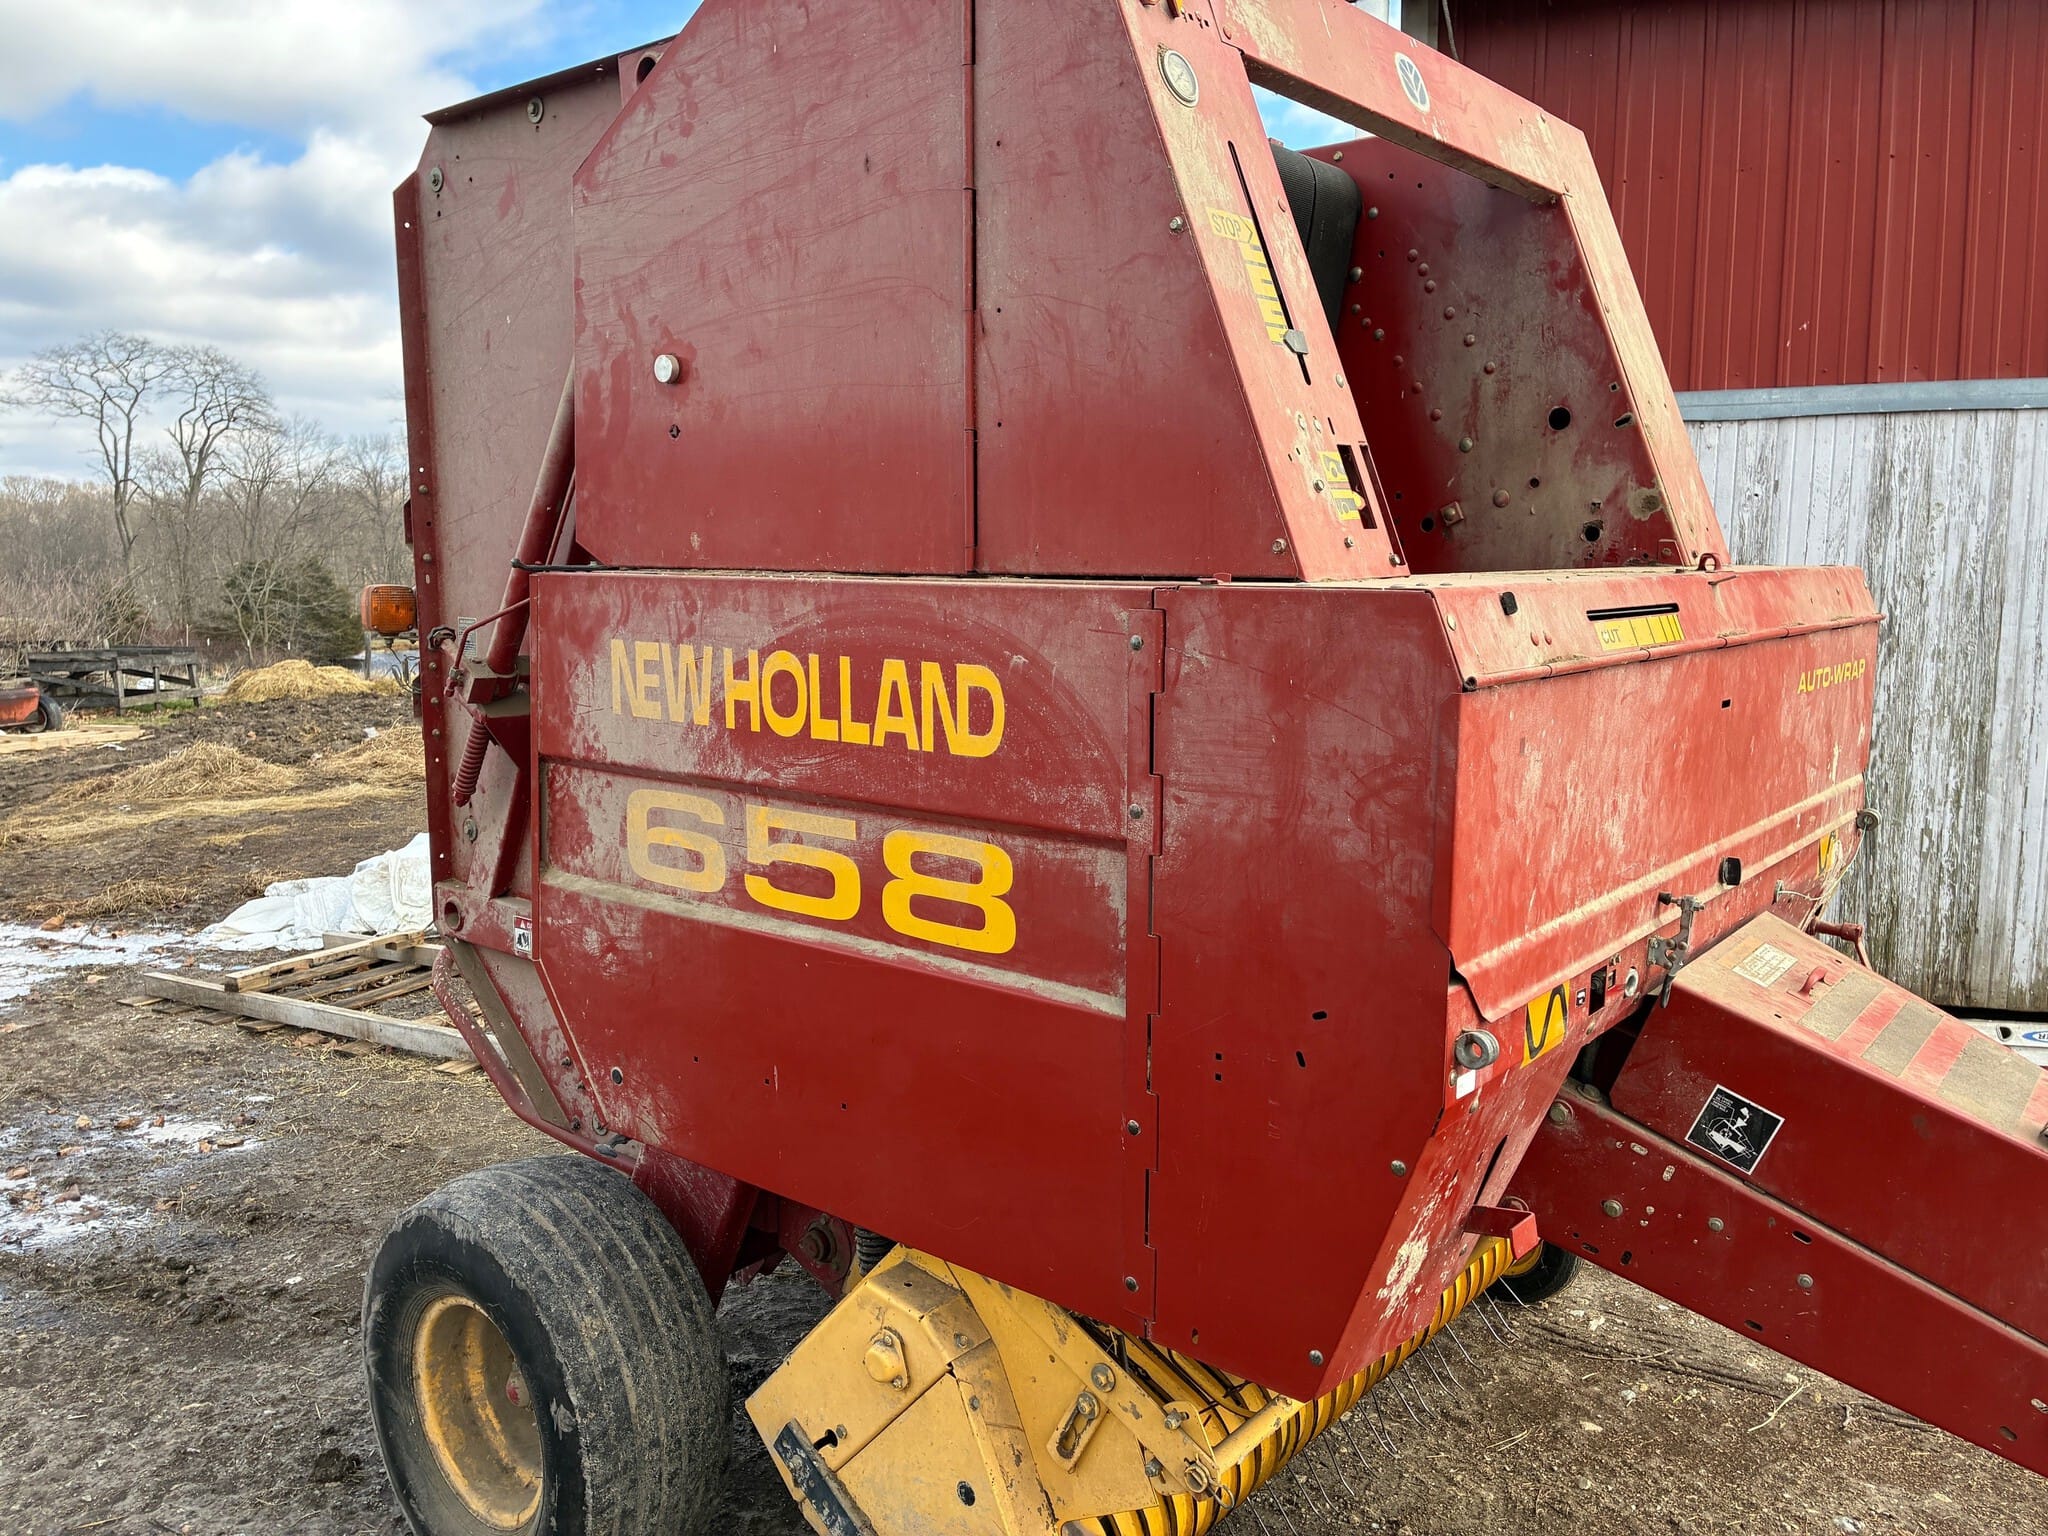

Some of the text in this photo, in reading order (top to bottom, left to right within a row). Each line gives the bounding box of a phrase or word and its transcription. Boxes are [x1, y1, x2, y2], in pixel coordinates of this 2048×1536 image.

[1211, 212, 1241, 238] STOP
[1601, 627, 1621, 644] CUT
[611, 639, 1005, 758] NEW HOLLAND
[626, 788, 1017, 954] 658
